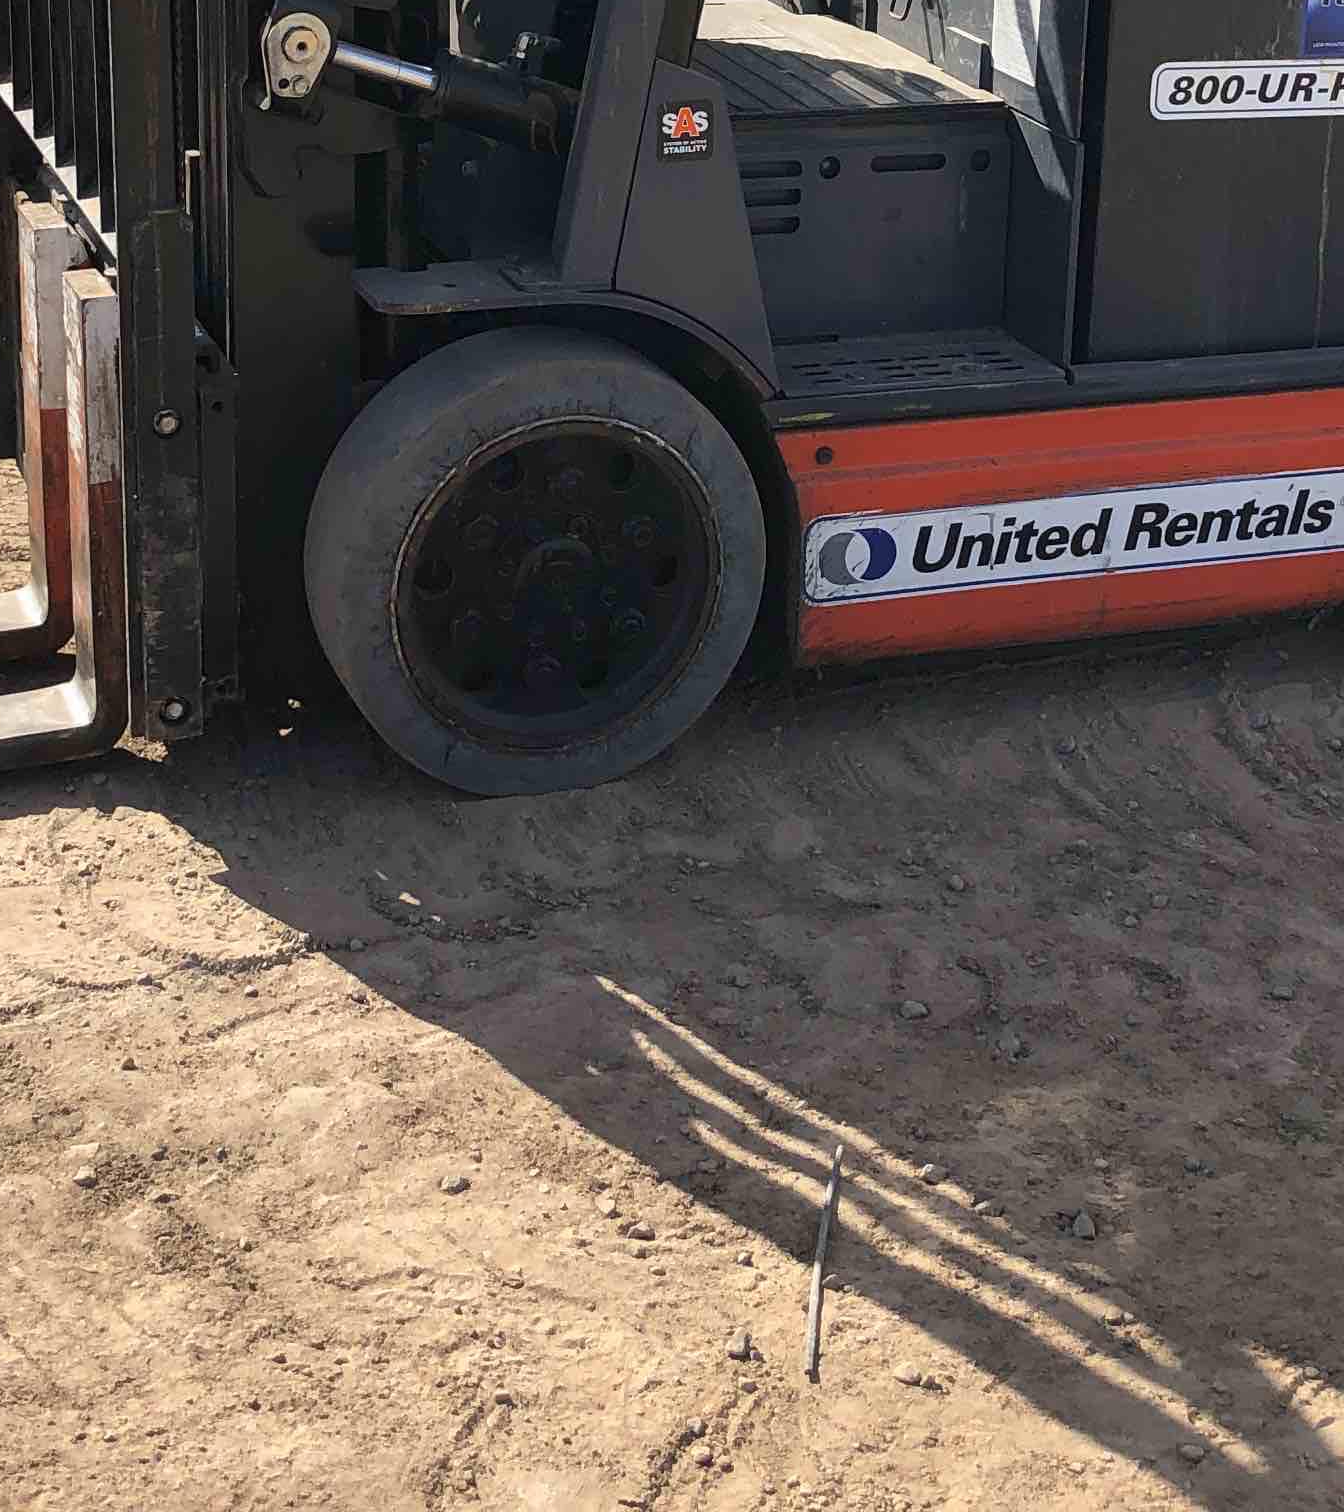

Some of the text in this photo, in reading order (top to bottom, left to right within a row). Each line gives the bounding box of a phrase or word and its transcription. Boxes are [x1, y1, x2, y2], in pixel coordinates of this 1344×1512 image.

[662, 107, 709, 138] SAS
[663, 144, 708, 155] STABILITY
[912, 488, 1336, 573] United Rentals
